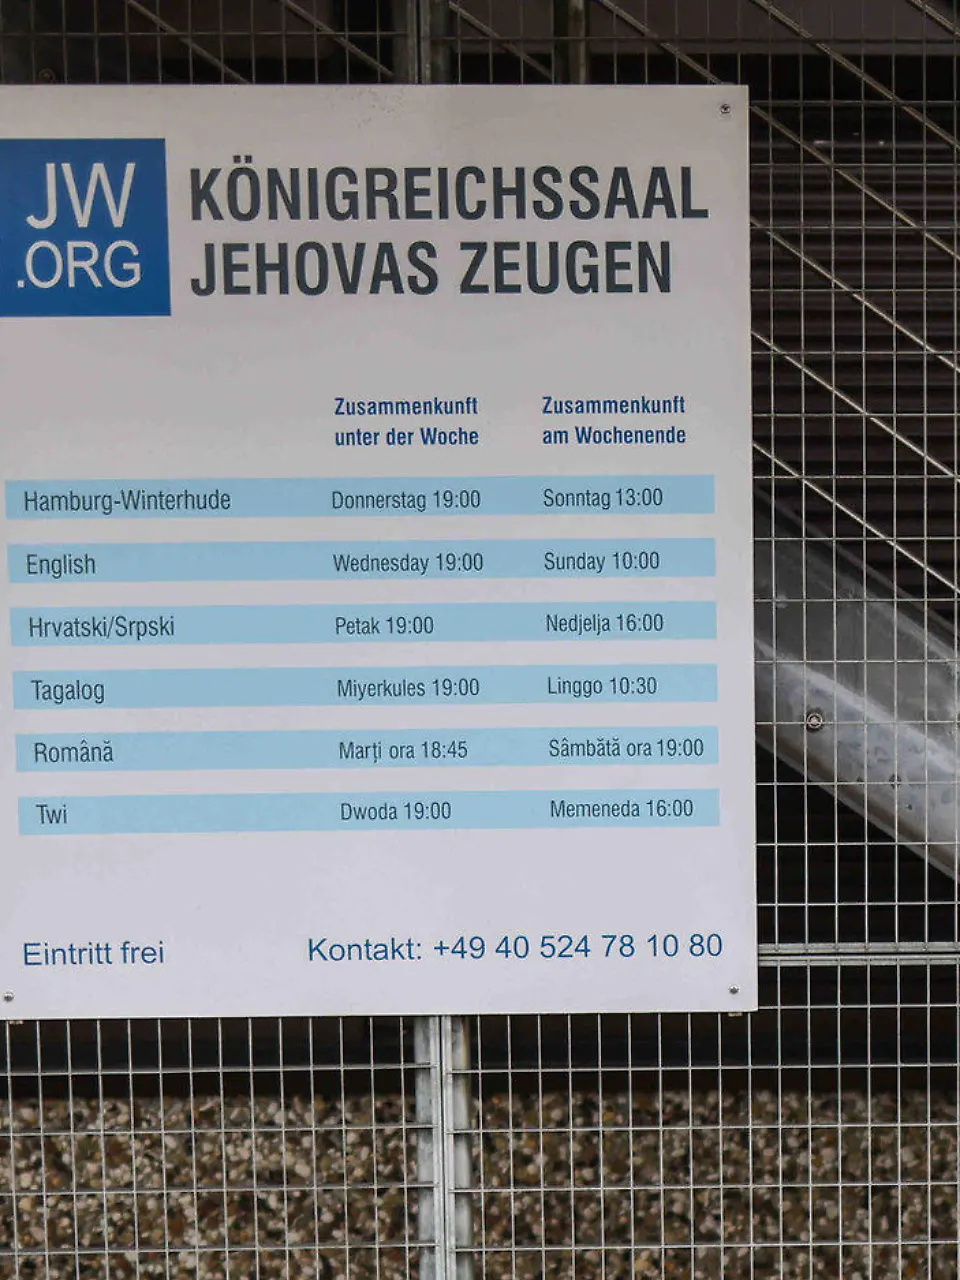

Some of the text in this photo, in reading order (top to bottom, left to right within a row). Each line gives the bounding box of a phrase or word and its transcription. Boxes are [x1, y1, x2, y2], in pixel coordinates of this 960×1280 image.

[26, 162, 136, 229] JW
[190, 155, 709, 222] KÖNIGREICHSSAAL
[17, 239, 141, 289] .ORG
[190, 240, 671, 297] JEHOVAS ZEUGEN
[334, 396, 478, 416] Zusammenkunft
[542, 395, 685, 415] Zusammenkunft
[335, 427, 479, 446] unter der Woche
[542, 425, 686, 445] am Wochenende
[24, 489, 231, 516] Hamburg-Winterhude
[332, 489, 481, 513] Donnerstag 19:00
[543, 488, 663, 510] Sonntag 13:00
[26, 553, 95, 580] English
[332, 552, 483, 576] Wednesday 19:00
[544, 551, 660, 574] Sunday 10:00
[29, 615, 174, 641] Hrvatski/Srpski
[335, 616, 434, 635] Petak 19:00
[546, 613, 664, 636] Nedjelja 16:00
[31, 679, 105, 705] Tagalog
[337, 678, 480, 701] Miyerkules 19:00
[548, 676, 657, 699] Linggo 10:30
[34, 739, 113, 763] Română
[389, 745, 415, 760] ora
[421, 740, 468, 759] 18:45
[626, 742, 652, 757] ora
[657, 738, 704, 757] 19:00
[35, 804, 67, 824] Twi
[340, 802, 451, 821] Dwoda 19:00
[550, 799, 693, 818] Memeneda 16:00
[23, 940, 164, 966] Eintritt frei
[308, 933, 723, 962] Kontakt: +49 40 524 78 10 80
